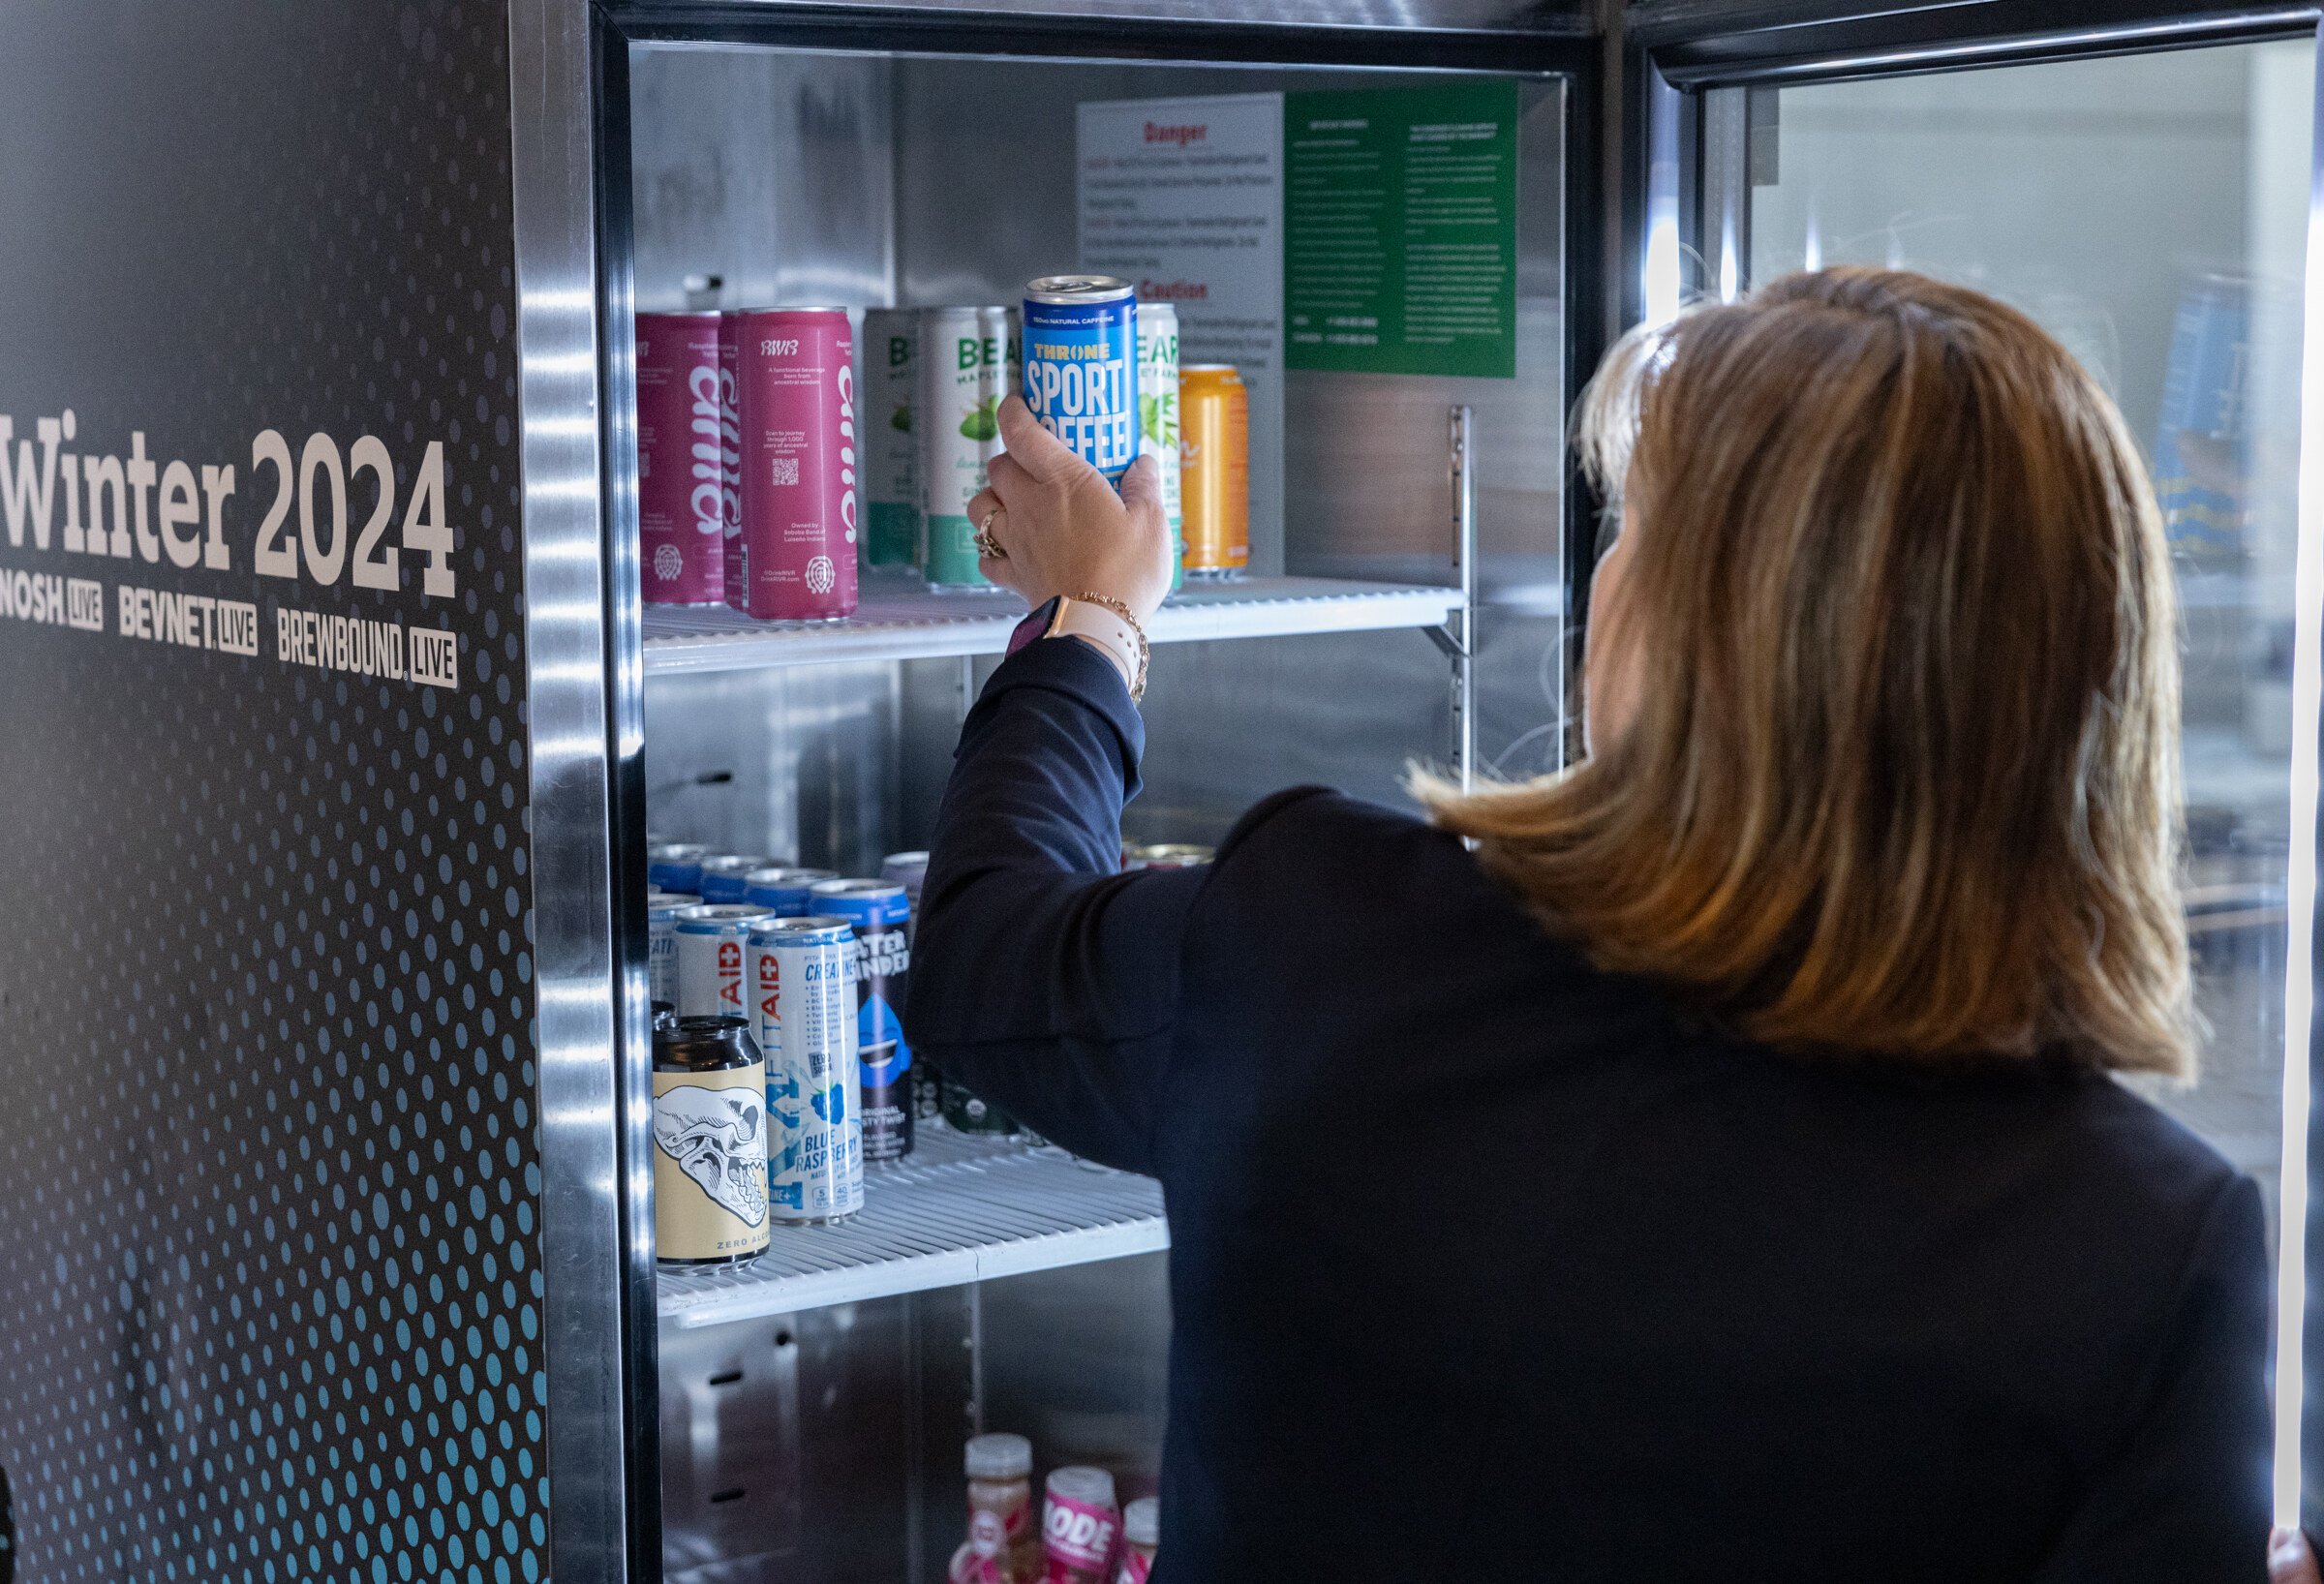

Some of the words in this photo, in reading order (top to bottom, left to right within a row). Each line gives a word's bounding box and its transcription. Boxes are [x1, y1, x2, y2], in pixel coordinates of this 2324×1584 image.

[1082, 315, 1115, 324] CAFFEINE
[1034, 343, 1110, 361] THRONE
[1027, 358, 1123, 416] SPORT
[0, 409, 235, 570] Winter
[252, 429, 456, 598] 2024
[0, 567, 64, 625] NOSH
[70, 581, 101, 626] LIVE
[118, 585, 216, 650] BEVNET
[220, 603, 257, 652] LIVE
[277, 607, 403, 681] BREWBOUND
[412, 631, 456, 684] LIVE
[795, 1134, 858, 1173] RASPBERRY
[805, 1128, 836, 1153] BLUE
[717, 1237, 748, 1250] ZERO
